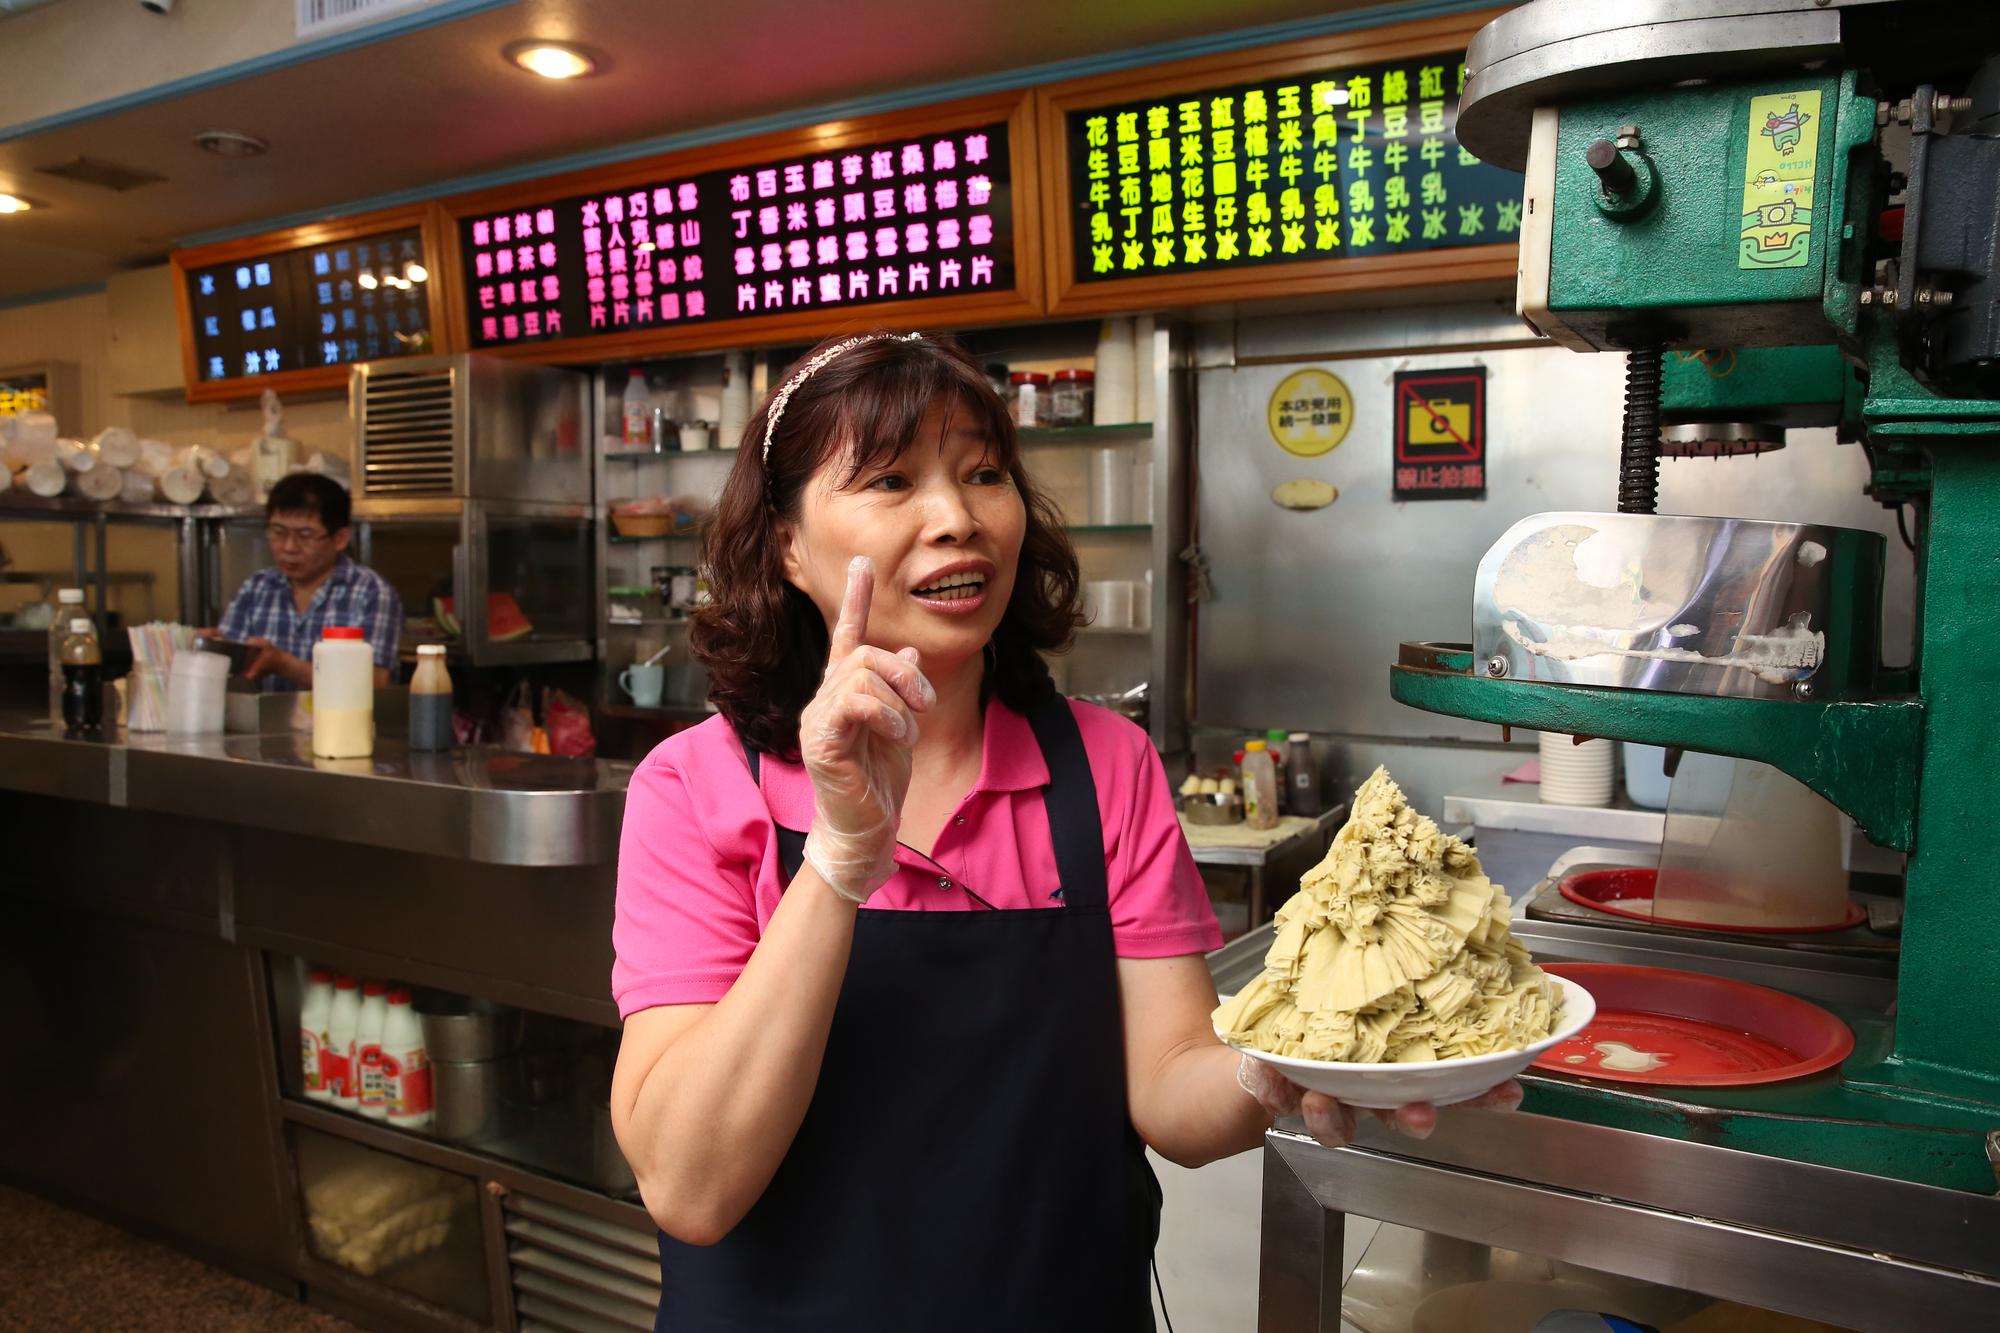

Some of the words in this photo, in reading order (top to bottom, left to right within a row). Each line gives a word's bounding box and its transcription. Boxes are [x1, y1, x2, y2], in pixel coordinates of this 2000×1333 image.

[841, 155, 869, 298] 芋頭雪片
[871, 151, 899, 295] 紅豆雪片
[933, 141, 961, 288] 烏梅雪片
[1086, 116, 1114, 273] 花生牛乳冰
[1116, 112, 1144, 270] 紅豆布丁冰
[1147, 106, 1175, 267] 芋頭地瓜冰
[1179, 101, 1207, 263] 玉米花生冰
[1277, 86, 1306, 253] 玉米牛乳冰
[1347, 76, 1375, 246] 布丁牛乳冰
[1383, 71, 1410, 243] 綠豆牛乳冰
[1420, 67, 1446, 239] 紅豆牛乳冰
[629, 192, 655, 324] 巧克力雪片
[730, 175, 756, 311] 布丁雪片
[757, 170, 784, 308] 百香雪片
[784, 165, 811, 304] 玉米雪片
